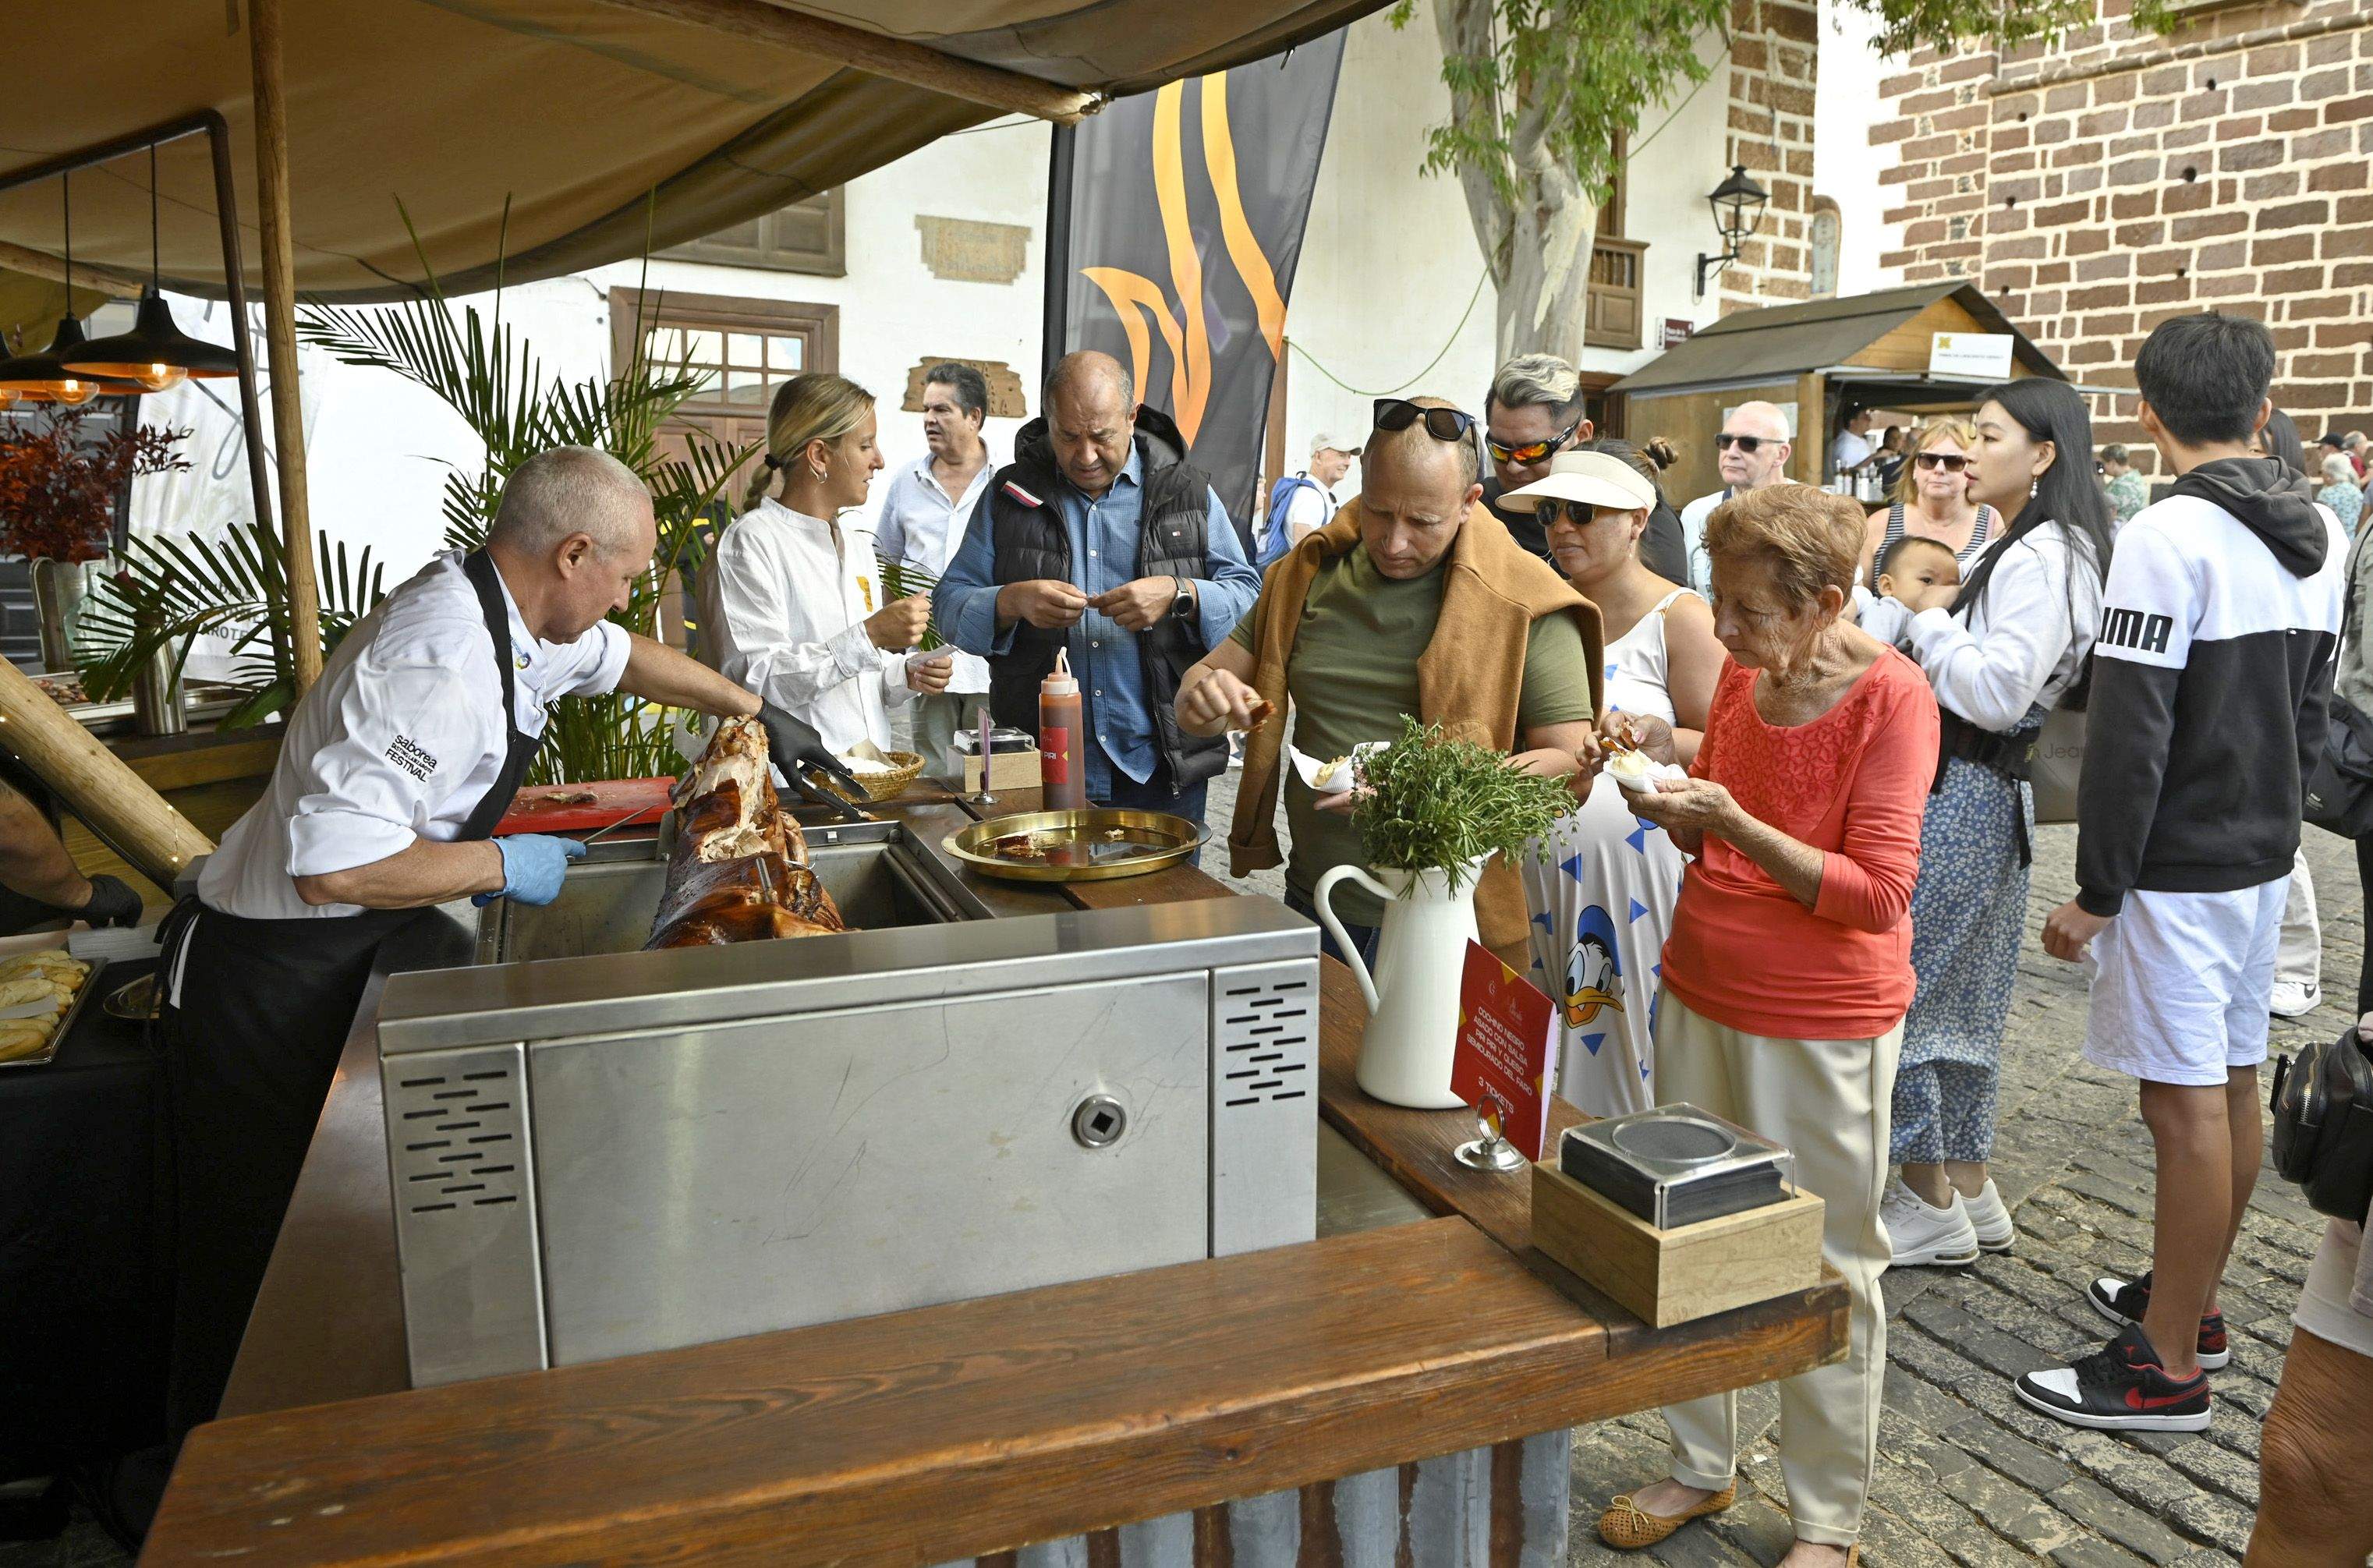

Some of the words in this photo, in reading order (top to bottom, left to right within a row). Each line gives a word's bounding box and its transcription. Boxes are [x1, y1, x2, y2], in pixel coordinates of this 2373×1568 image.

[384, 748, 427, 783] FESTIVAL
[1473, 1014, 1493, 1037] ASADO
[1493, 1032, 1507, 1049] CON
[1507, 1044, 1528, 1067] SALSA
[1479, 1006, 1503, 1033] COCHINO
[1503, 1028, 1525, 1051] NEGRO
[1496, 1046, 1503, 1057] Y
[1503, 1053, 1525, 1076] QUESO
[1478, 1076, 1484, 1087] 3
[1485, 1081, 1514, 1115] TICKETS
[1503, 1065, 1516, 1083] DEL
[1515, 1076, 1533, 1096] FARO
